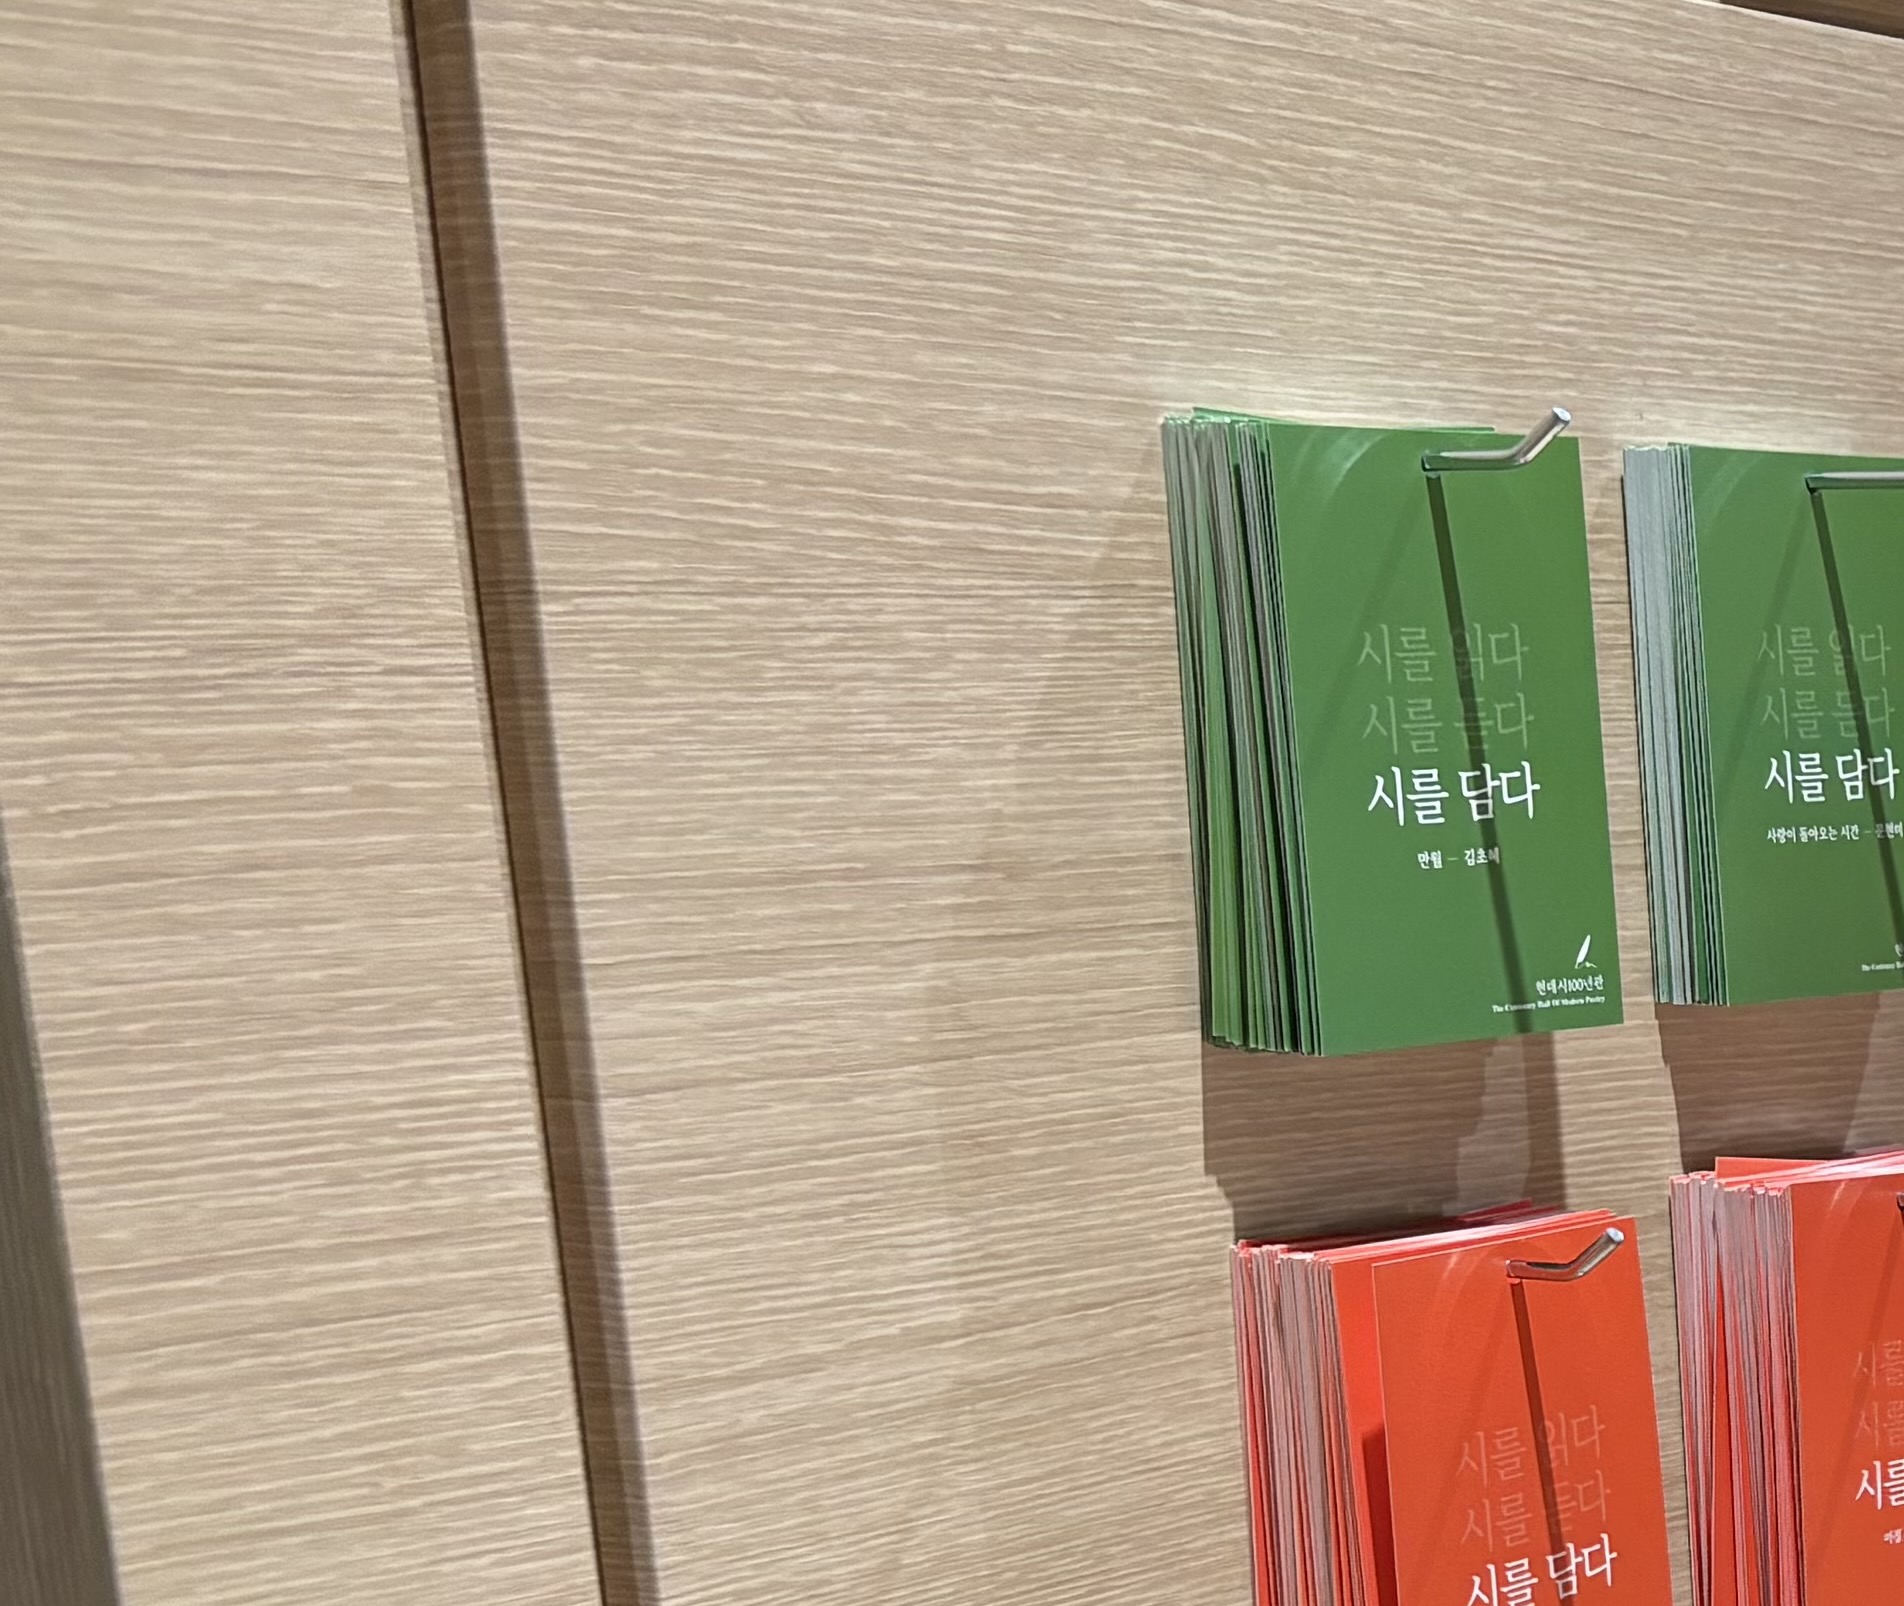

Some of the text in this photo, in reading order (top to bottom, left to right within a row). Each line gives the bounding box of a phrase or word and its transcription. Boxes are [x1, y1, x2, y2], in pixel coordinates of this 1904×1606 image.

[1356, 623, 1437, 684] 시를
[1756, 623, 1819, 676] 시를
[1362, 695, 1443, 755] 시를
[1761, 688, 1824, 740] 시를
[1367, 760, 1541, 827] 시를 담다
[1764, 747, 1901, 804] 시를 담다
[1417, 849, 1443, 870] 만월
[1767, 826, 1797, 844] 사랑이
[1798, 825, 1838, 843] 돌아오는
[1840, 823, 1860, 841] 시간
[1456, 1426, 1528, 1488] 시를
[1460, 1491, 1534, 1553] 시를
[1545, 1532, 1618, 1600] 담다
